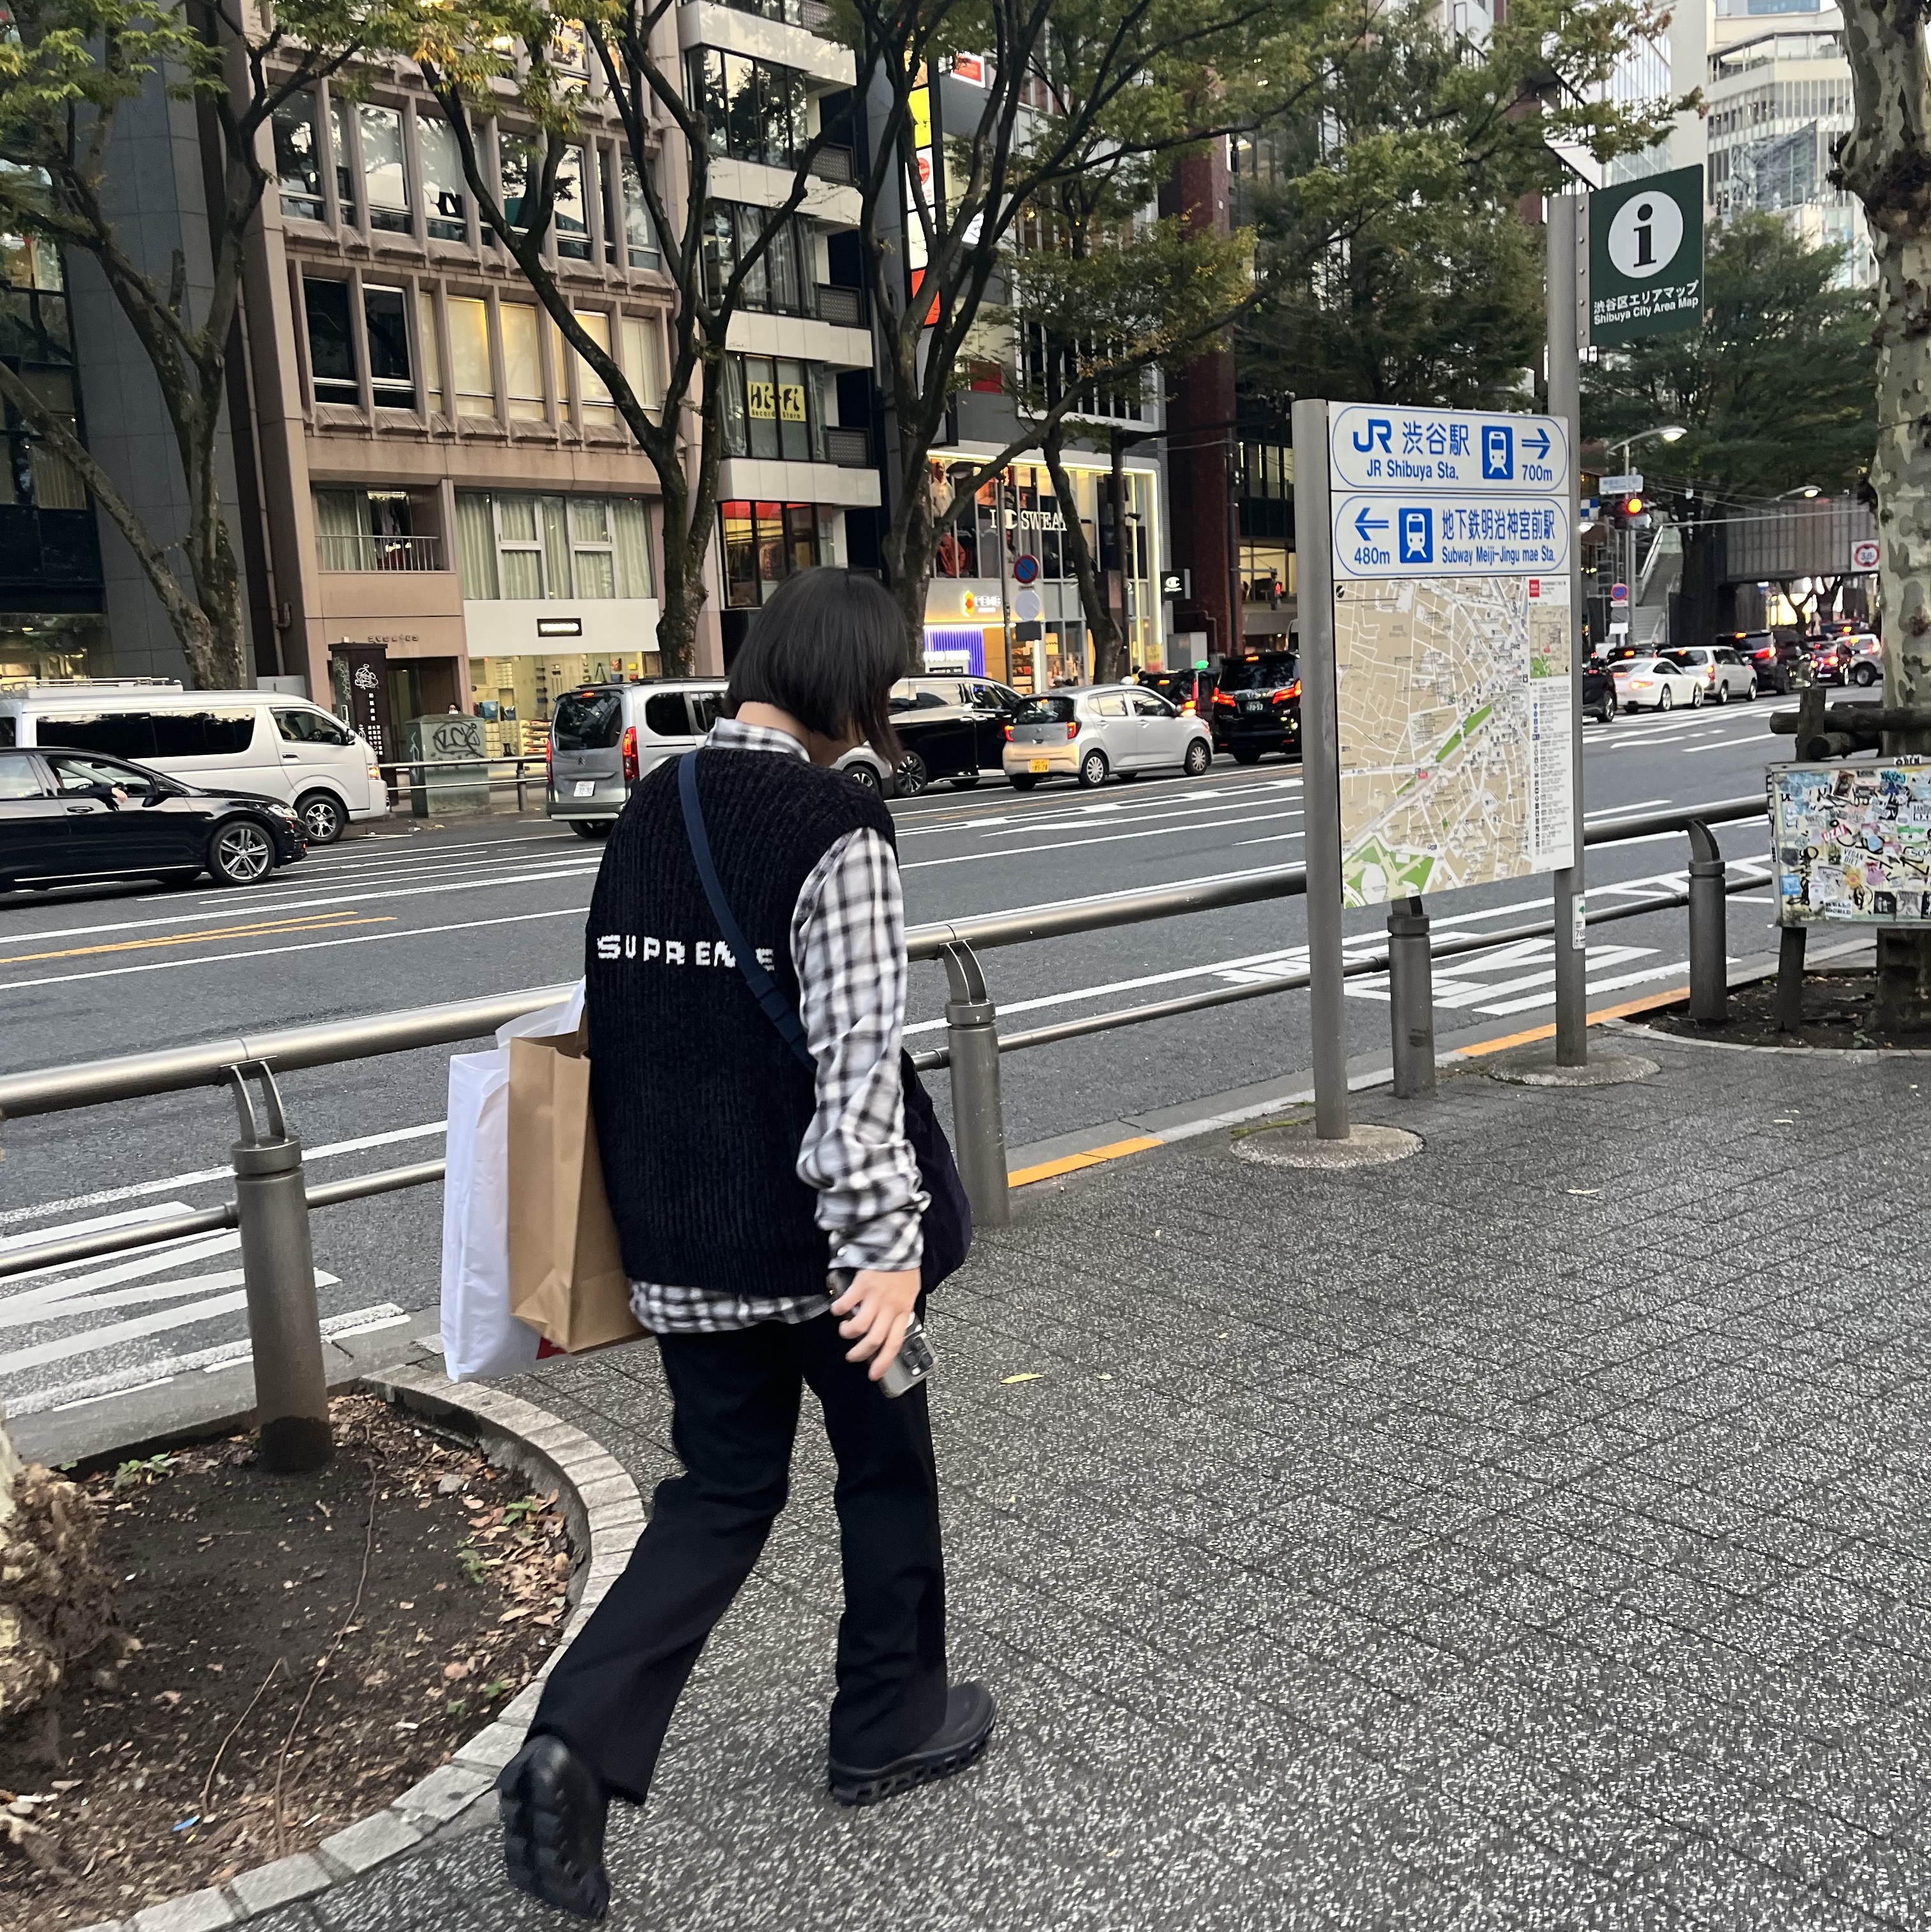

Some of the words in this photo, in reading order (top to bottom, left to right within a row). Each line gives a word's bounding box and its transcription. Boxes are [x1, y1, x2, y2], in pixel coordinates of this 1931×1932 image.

[1594, 279, 1699, 314] 渋谷区エリアマップ
[1594, 308, 1631, 325] Shibuya
[1633, 304, 1651, 317] City
[1654, 301, 1675, 313] Area
[1678, 296, 1699, 309] Map
[751, 384, 800, 411] Hi-Fi
[1352, 418, 1393, 454] JR
[1402, 420, 1470, 457] 渋谷駅
[1366, 459, 1382, 478] JR
[1387, 459, 1432, 482] Shibuya
[1437, 462, 1459, 480] Sta.
[1522, 465, 1553, 481] 700m
[1020, 510, 1068, 531] SWEA
[1442, 508, 1555, 541] 地下鉄明治神宮前駅
[1354, 547, 1390, 565] 480m
[1442, 545, 1472, 567] Subway
[1476, 546, 1520, 566] Meiji-Jingu
[1522, 550, 1538, 563] mae
[1541, 546, 1556, 563] Sta.
[1844, 848, 1864, 860] VEGAN
[1844, 856, 1858, 866] DIET
